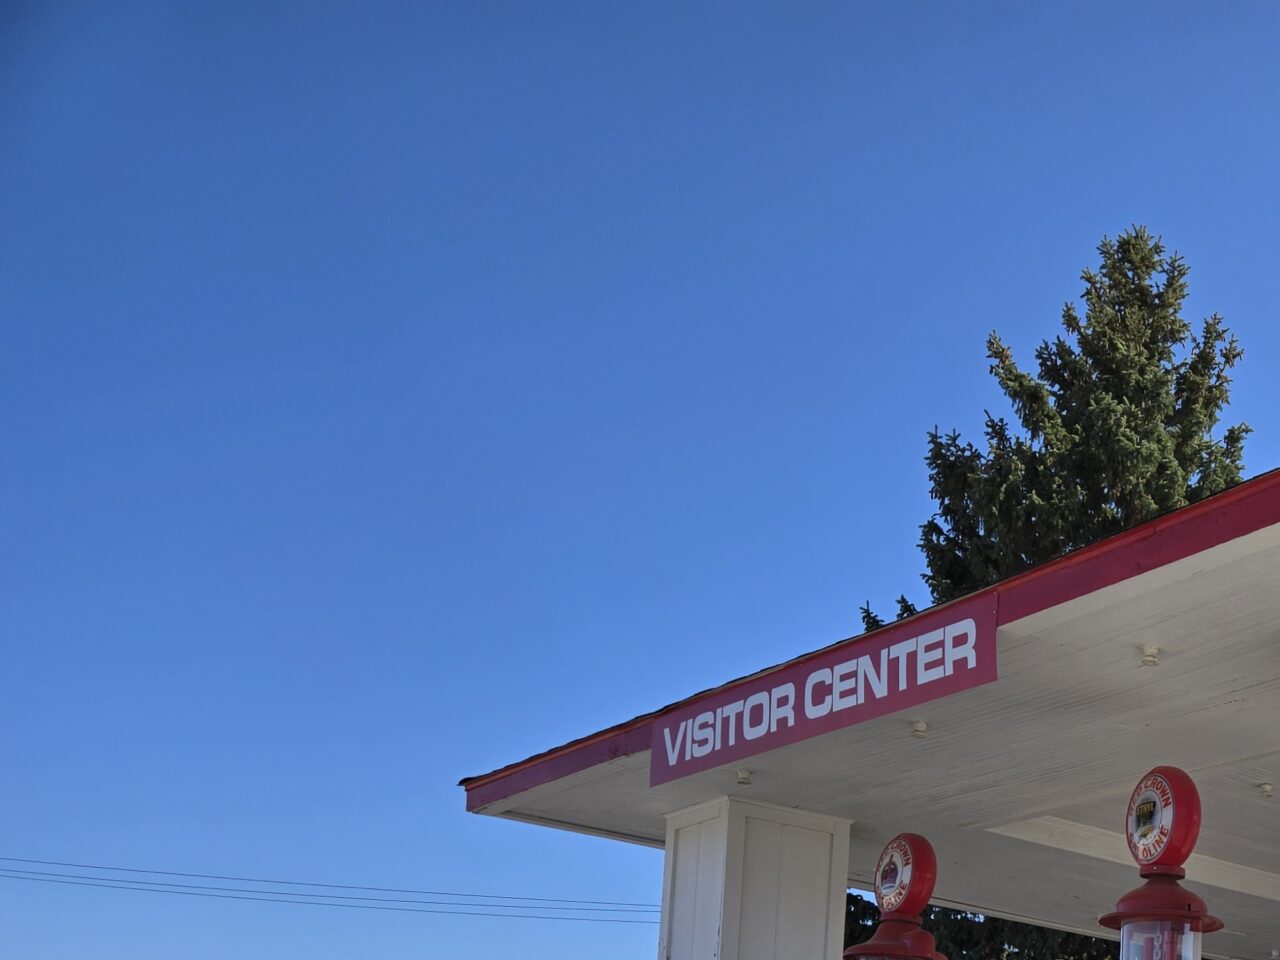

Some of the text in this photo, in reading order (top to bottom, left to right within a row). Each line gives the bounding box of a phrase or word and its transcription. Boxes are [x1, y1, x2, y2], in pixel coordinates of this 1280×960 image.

[663, 618, 977, 766] VISITOR CENTER
[1144, 776, 1172, 808] CROWN
[891, 840, 912, 867] CROWN
